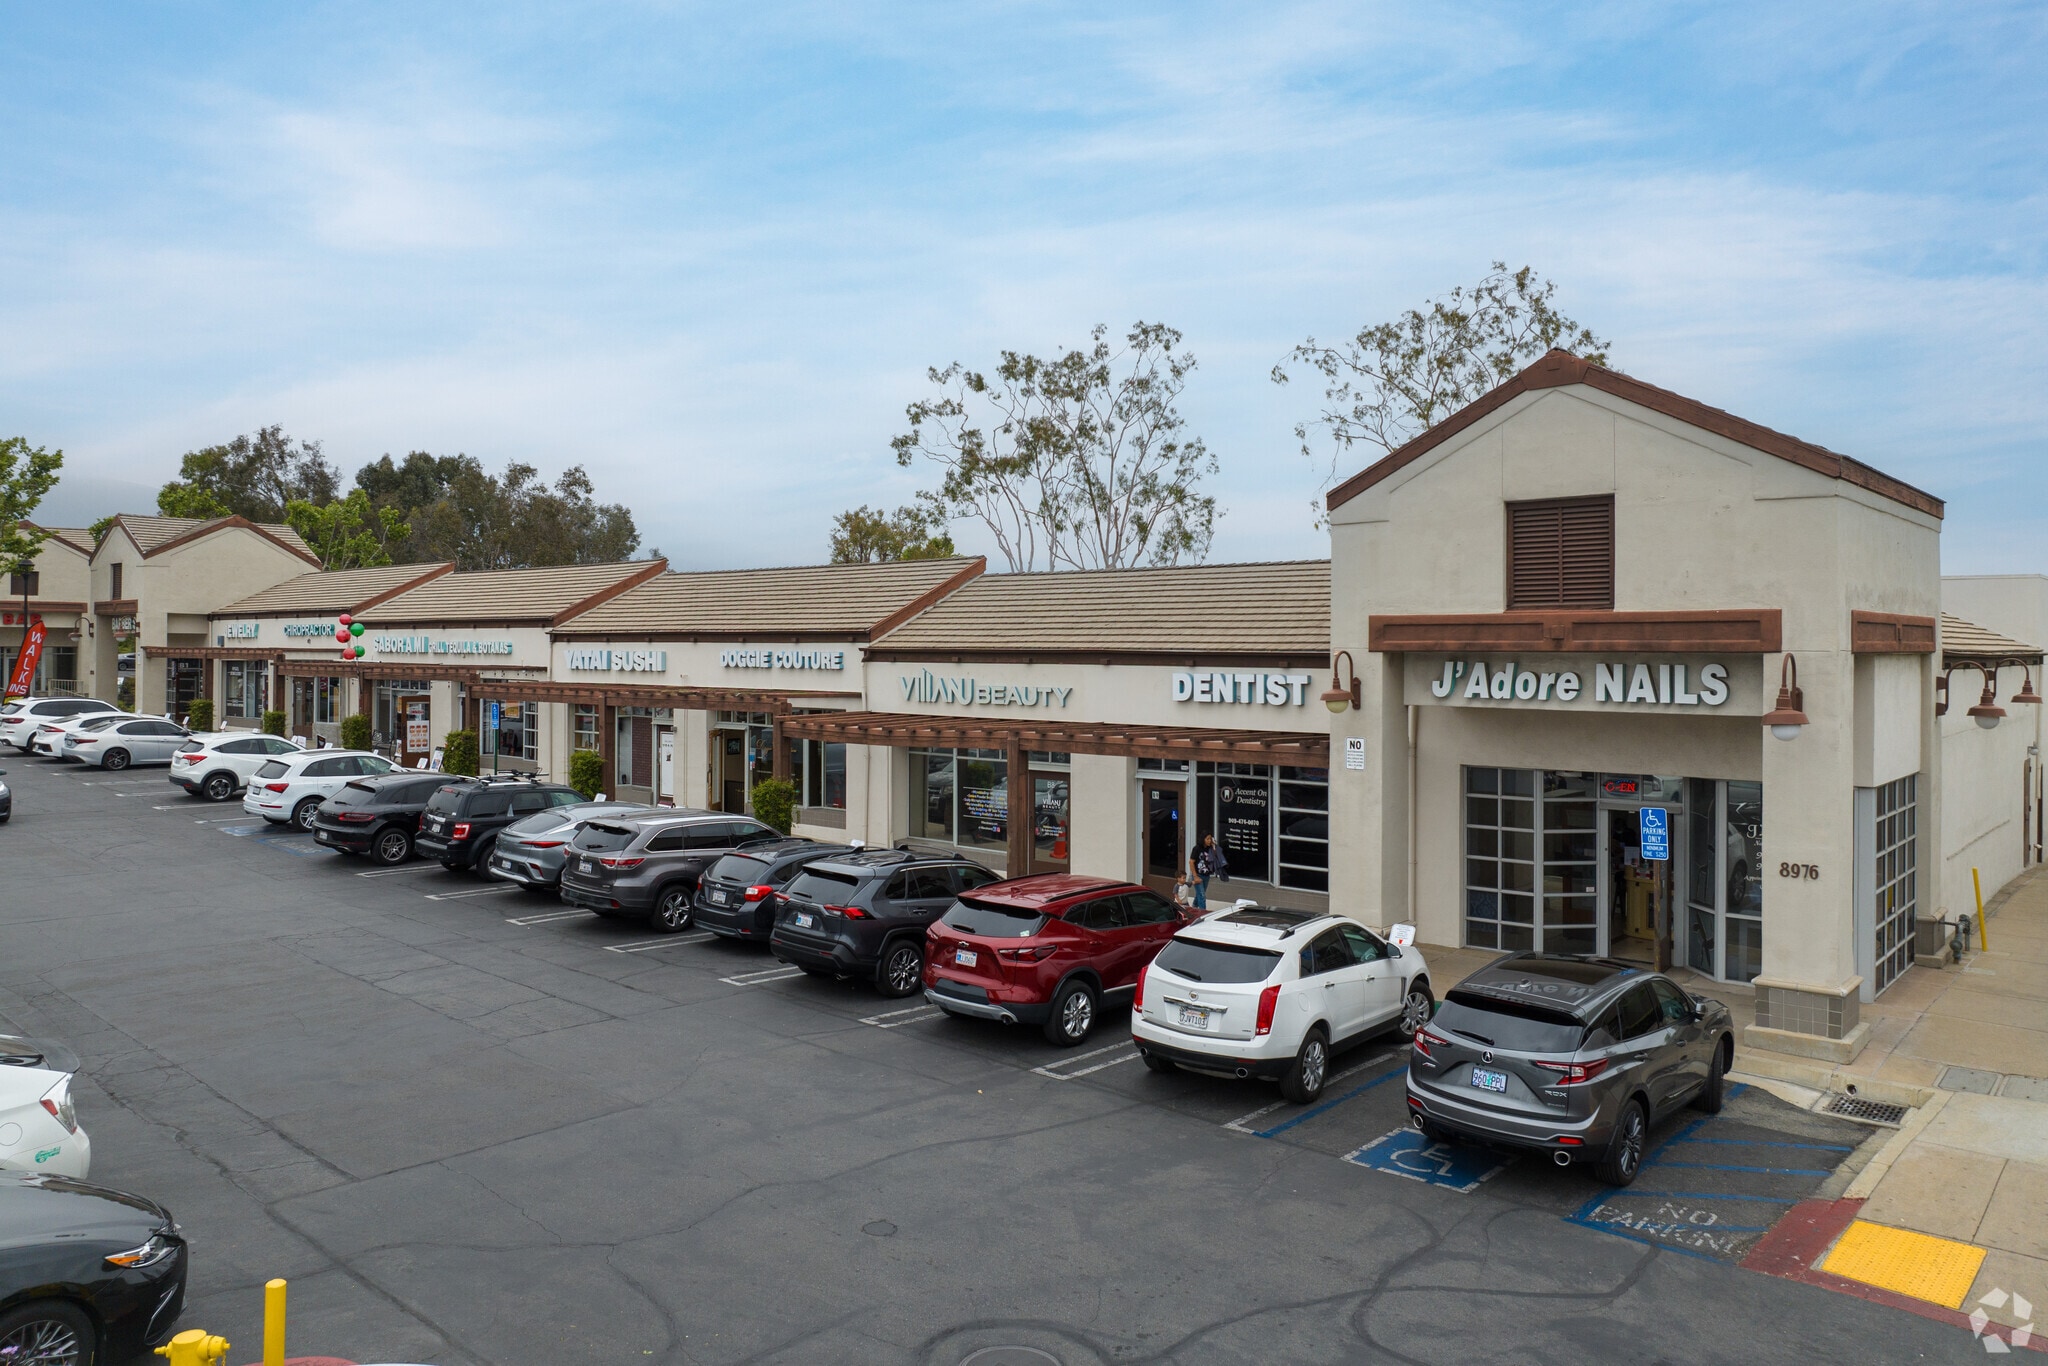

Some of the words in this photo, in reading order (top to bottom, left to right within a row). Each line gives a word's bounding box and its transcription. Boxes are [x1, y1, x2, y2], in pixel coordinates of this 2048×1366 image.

[284, 624, 335, 636] CHIROPRACTOR
[479, 641, 512, 654] BOTANAS
[564, 650, 611, 670] YATAI
[612, 651, 666, 671] SUSHI
[720, 651, 772, 668] DOGGIE
[775, 651, 844, 670] COUTURE
[9, 683, 28, 694] INS
[1172, 673, 1310, 706] DENTIST
[1432, 661, 1581, 701] J'Adore
[1595, 663, 1728, 705] NAILS
[978, 685, 1073, 707] BEAUTY
[1350, 740, 1361, 750] NO
[1235, 788, 1256, 796] Accent
[1258, 789, 1267, 797] On
[1605, 781, 1635, 792] OEN
[1237, 797, 1266, 807] Dentistry
[1643, 827, 1666, 835] PARKING
[1648, 835, 1661, 843] ONLY
[1779, 862, 1819, 880] 8976
[1473, 1072, 1487, 1084] 960
[1491, 1075, 1504, 1088] PPL
[1657, 1202, 1718, 1226] NO
